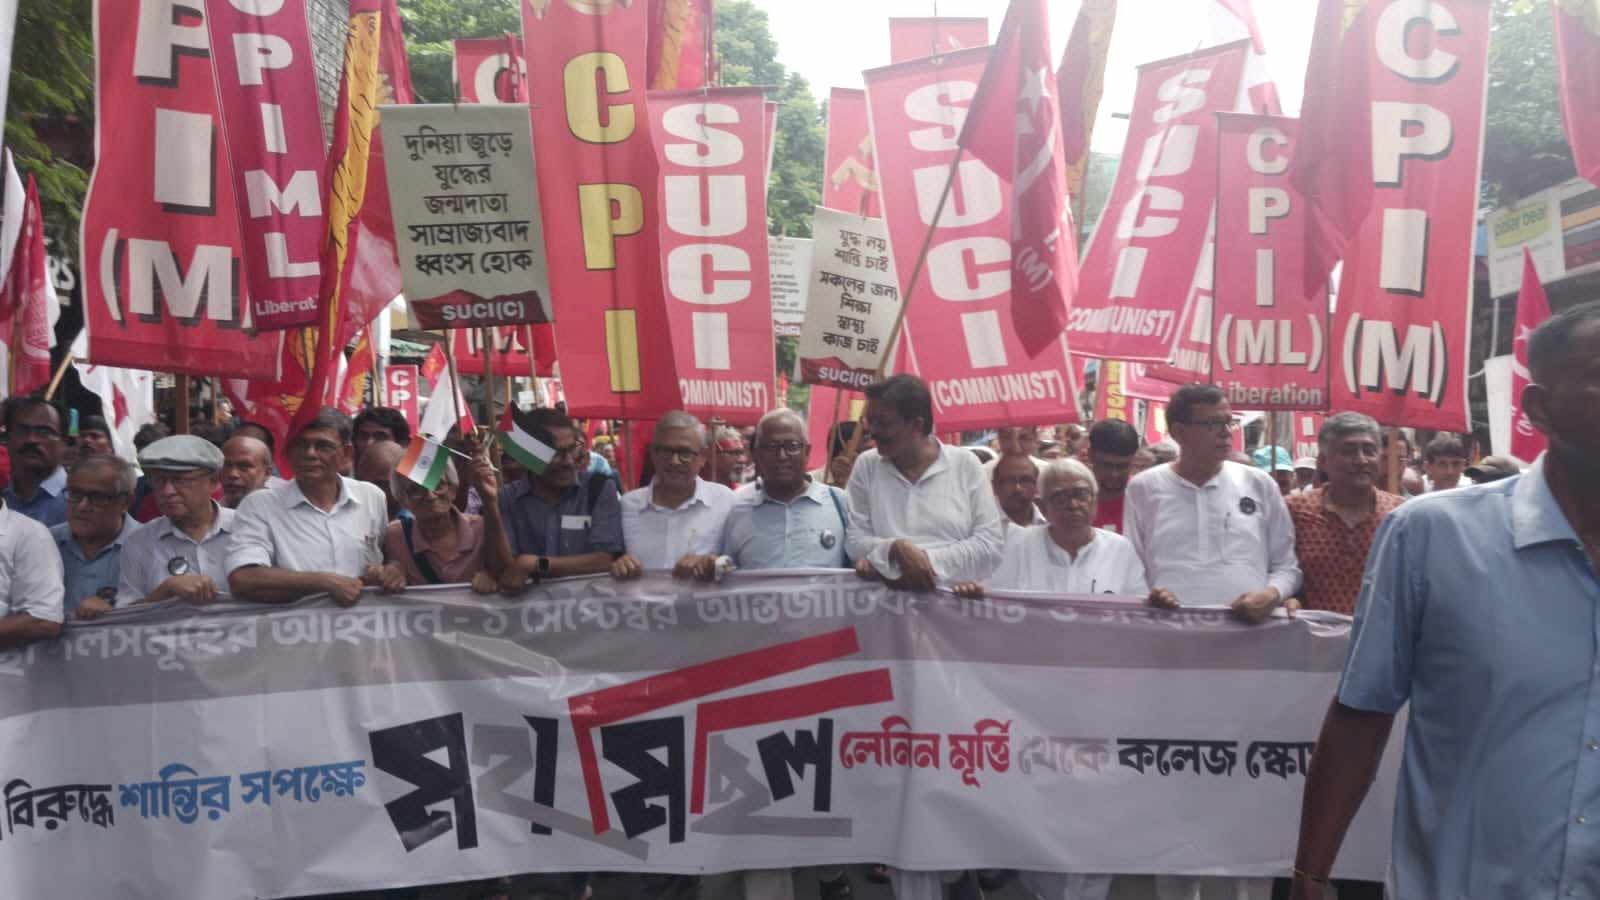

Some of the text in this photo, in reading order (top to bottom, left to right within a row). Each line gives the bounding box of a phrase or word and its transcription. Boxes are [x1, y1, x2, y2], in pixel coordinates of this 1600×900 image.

[404, 125, 513, 161] দুনিয়া জুড়ে
[432, 164, 491, 191] যুদ্ধের
[424, 193, 508, 215] জন্মদাতা
[1246, 128, 1291, 306] CPI
[408, 220, 530, 246] সাম্রাজ্যবাদ
[661, 103, 752, 370] SUCI
[415, 249, 533, 276] ধ্বংস হোক
[442, 303, 525, 322] SUCI(C)
[1066, 306, 1176, 345] COMMUNIST)
[679, 379, 768, 416] OMMUNIST)
[931, 368, 1067, 413] (COMMUNIST)
[1222, 381, 1322, 404] iberation
[839, 715, 941, 769] লেনিন
[947, 718, 1013, 788] মূর্তি
[1117, 738, 1239, 777] কলেজ
[1245, 740, 1317, 779] স্কো
[3, 760, 366, 836] বিরুদ্ধে শান্তির সপক্ষে
